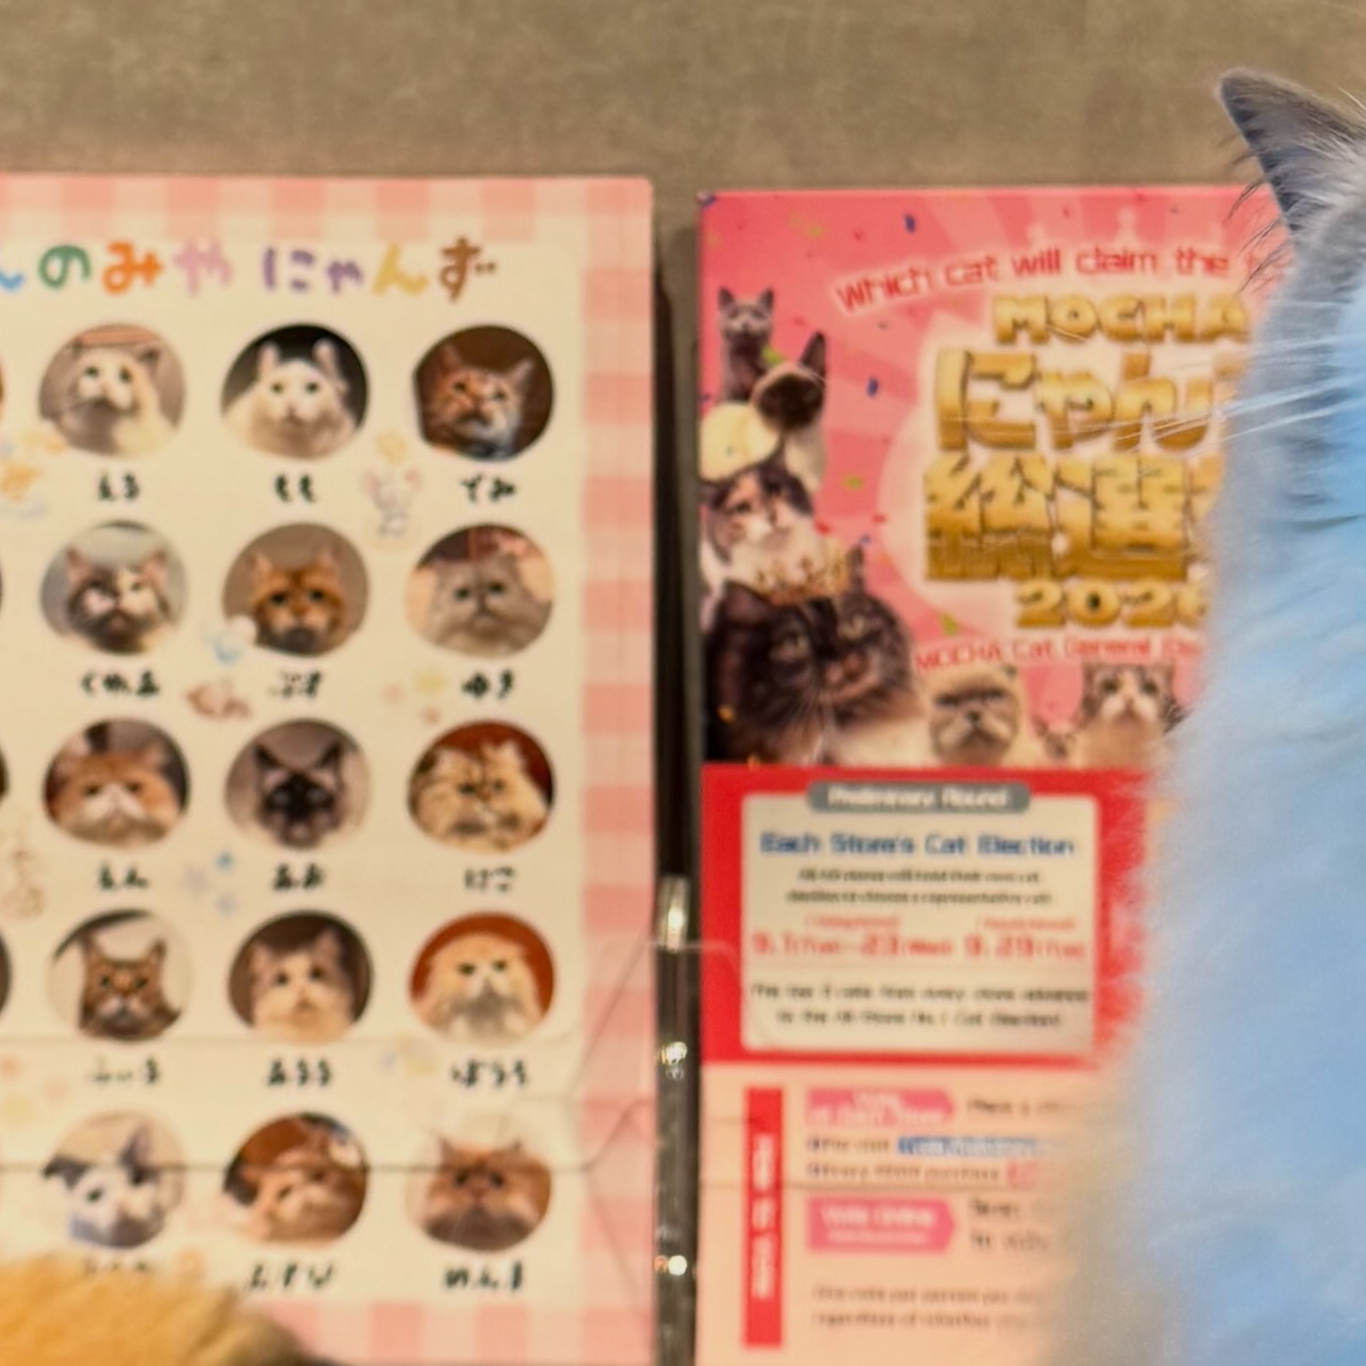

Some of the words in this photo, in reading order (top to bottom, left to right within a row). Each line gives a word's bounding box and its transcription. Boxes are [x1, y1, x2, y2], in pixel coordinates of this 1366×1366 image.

[838, 266, 932, 312] Which
[945, 255, 1000, 287] cat
[1012, 247, 1062, 278] will
[1076, 246, 1158, 276] claim
[1176, 246, 1230, 277] the
[993, 293, 1250, 345] MOCHA
[925, 834, 967, 856] Cat
